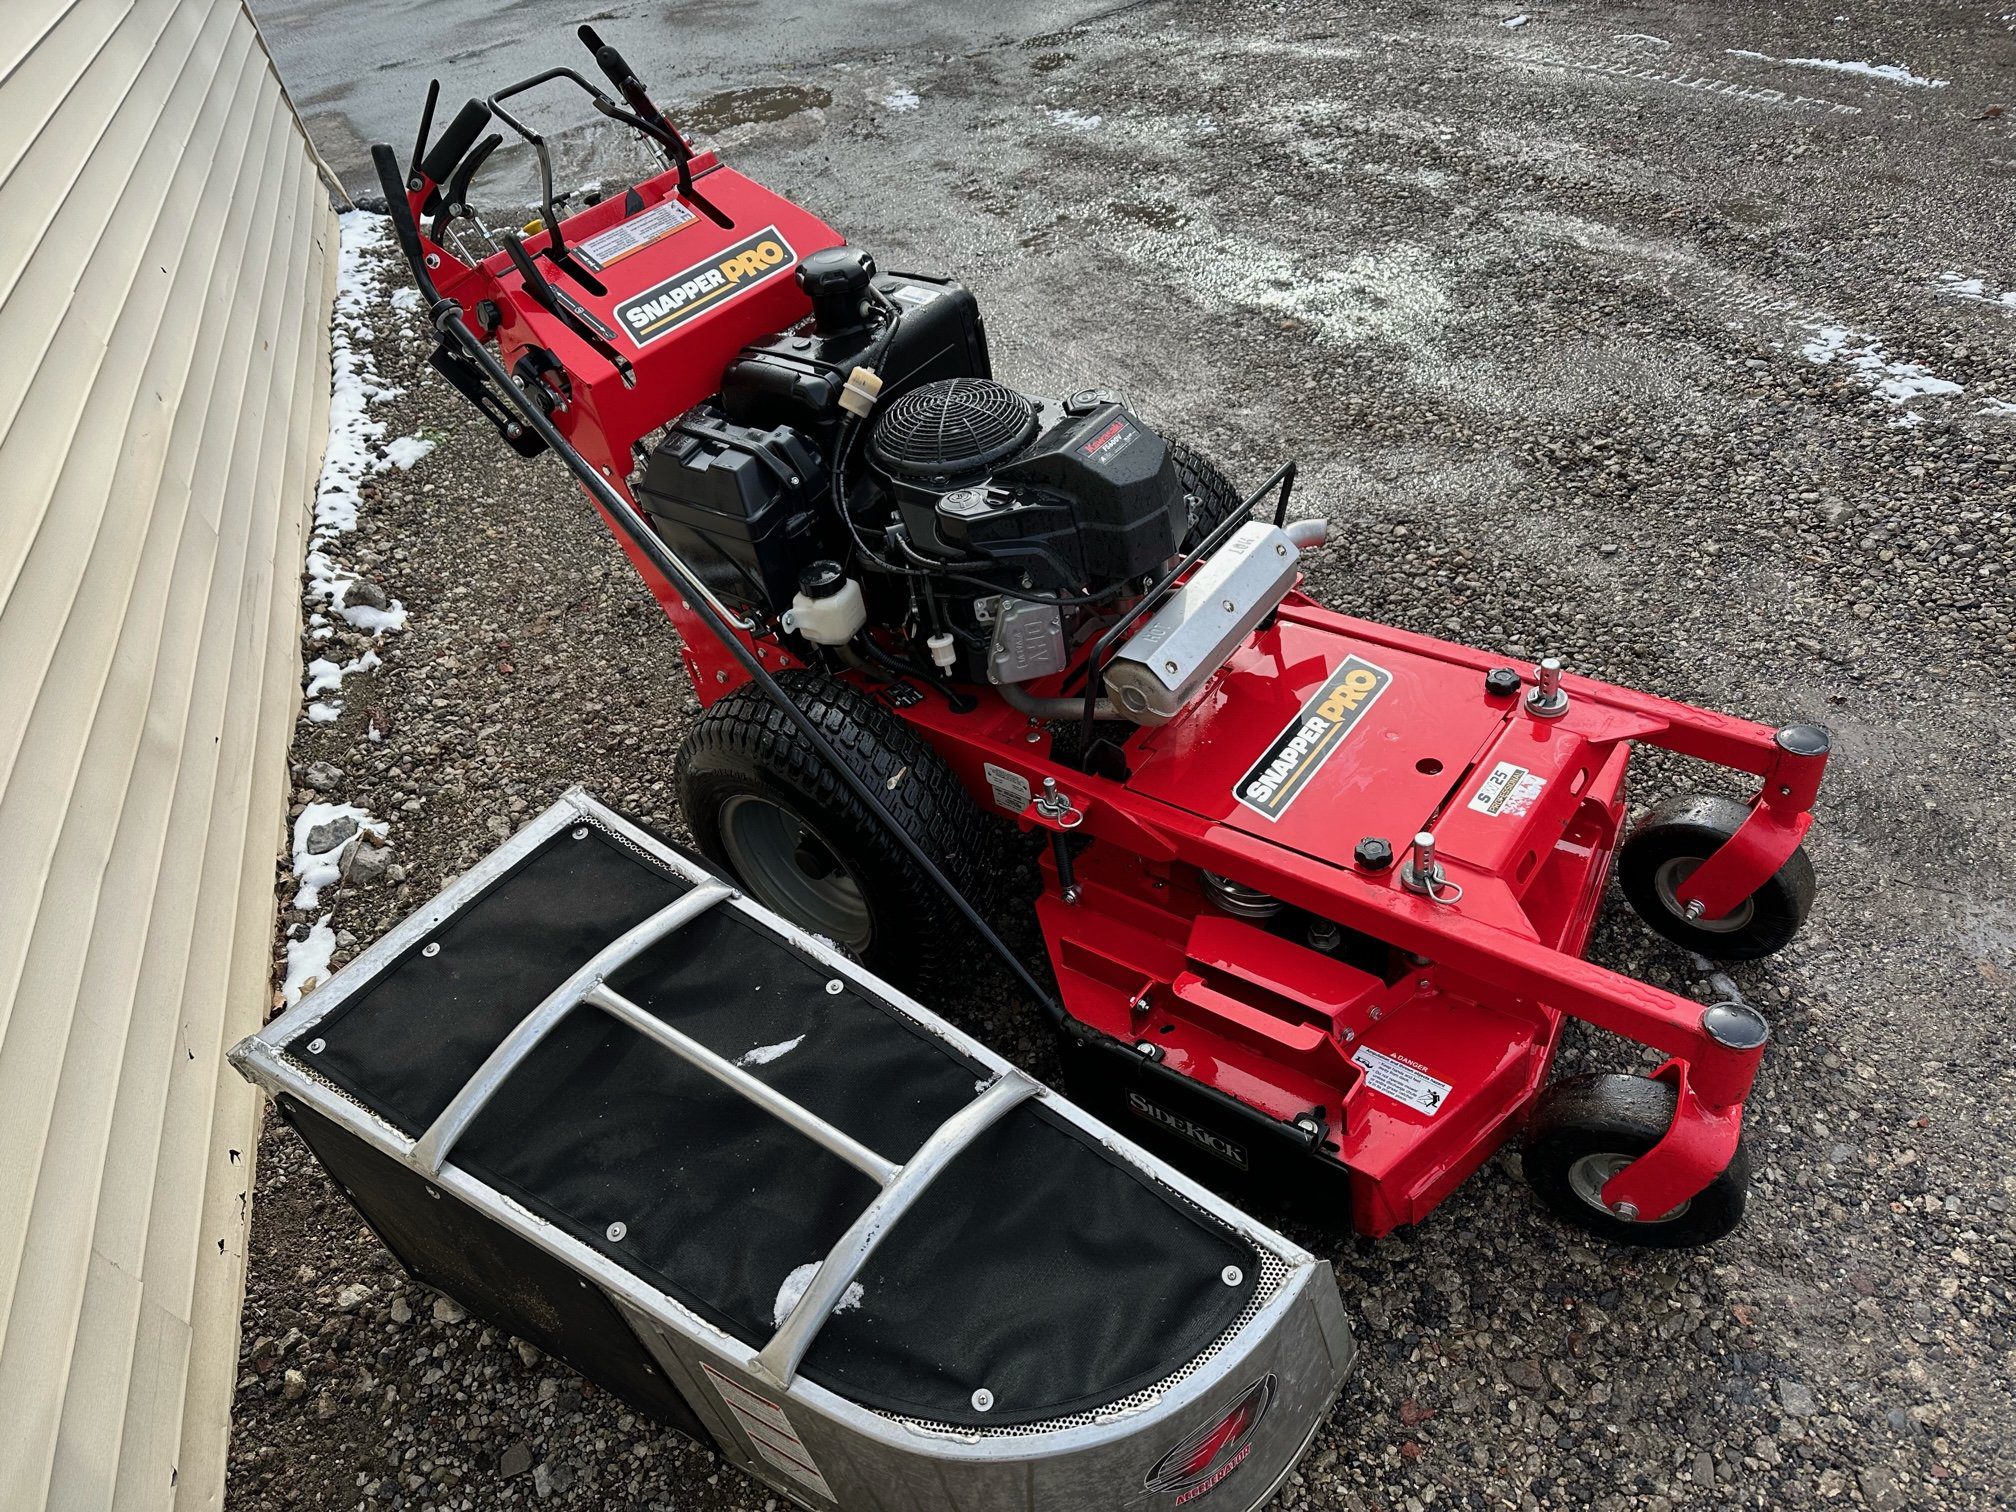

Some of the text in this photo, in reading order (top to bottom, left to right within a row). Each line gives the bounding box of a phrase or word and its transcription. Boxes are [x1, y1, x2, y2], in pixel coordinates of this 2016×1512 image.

[625, 240, 783, 329] SNAPPER PRO
[1084, 420, 1125, 454] Kawasaki
[1143, 622, 1171, 643] HOT
[1245, 669, 1377, 804] SNAPPER PRO
[1488, 771, 1523, 812] PROFESSIONAL
[1397, 1054, 1428, 1072] DANGER
[1176, 1442, 1252, 1506] ACCELERATOR
